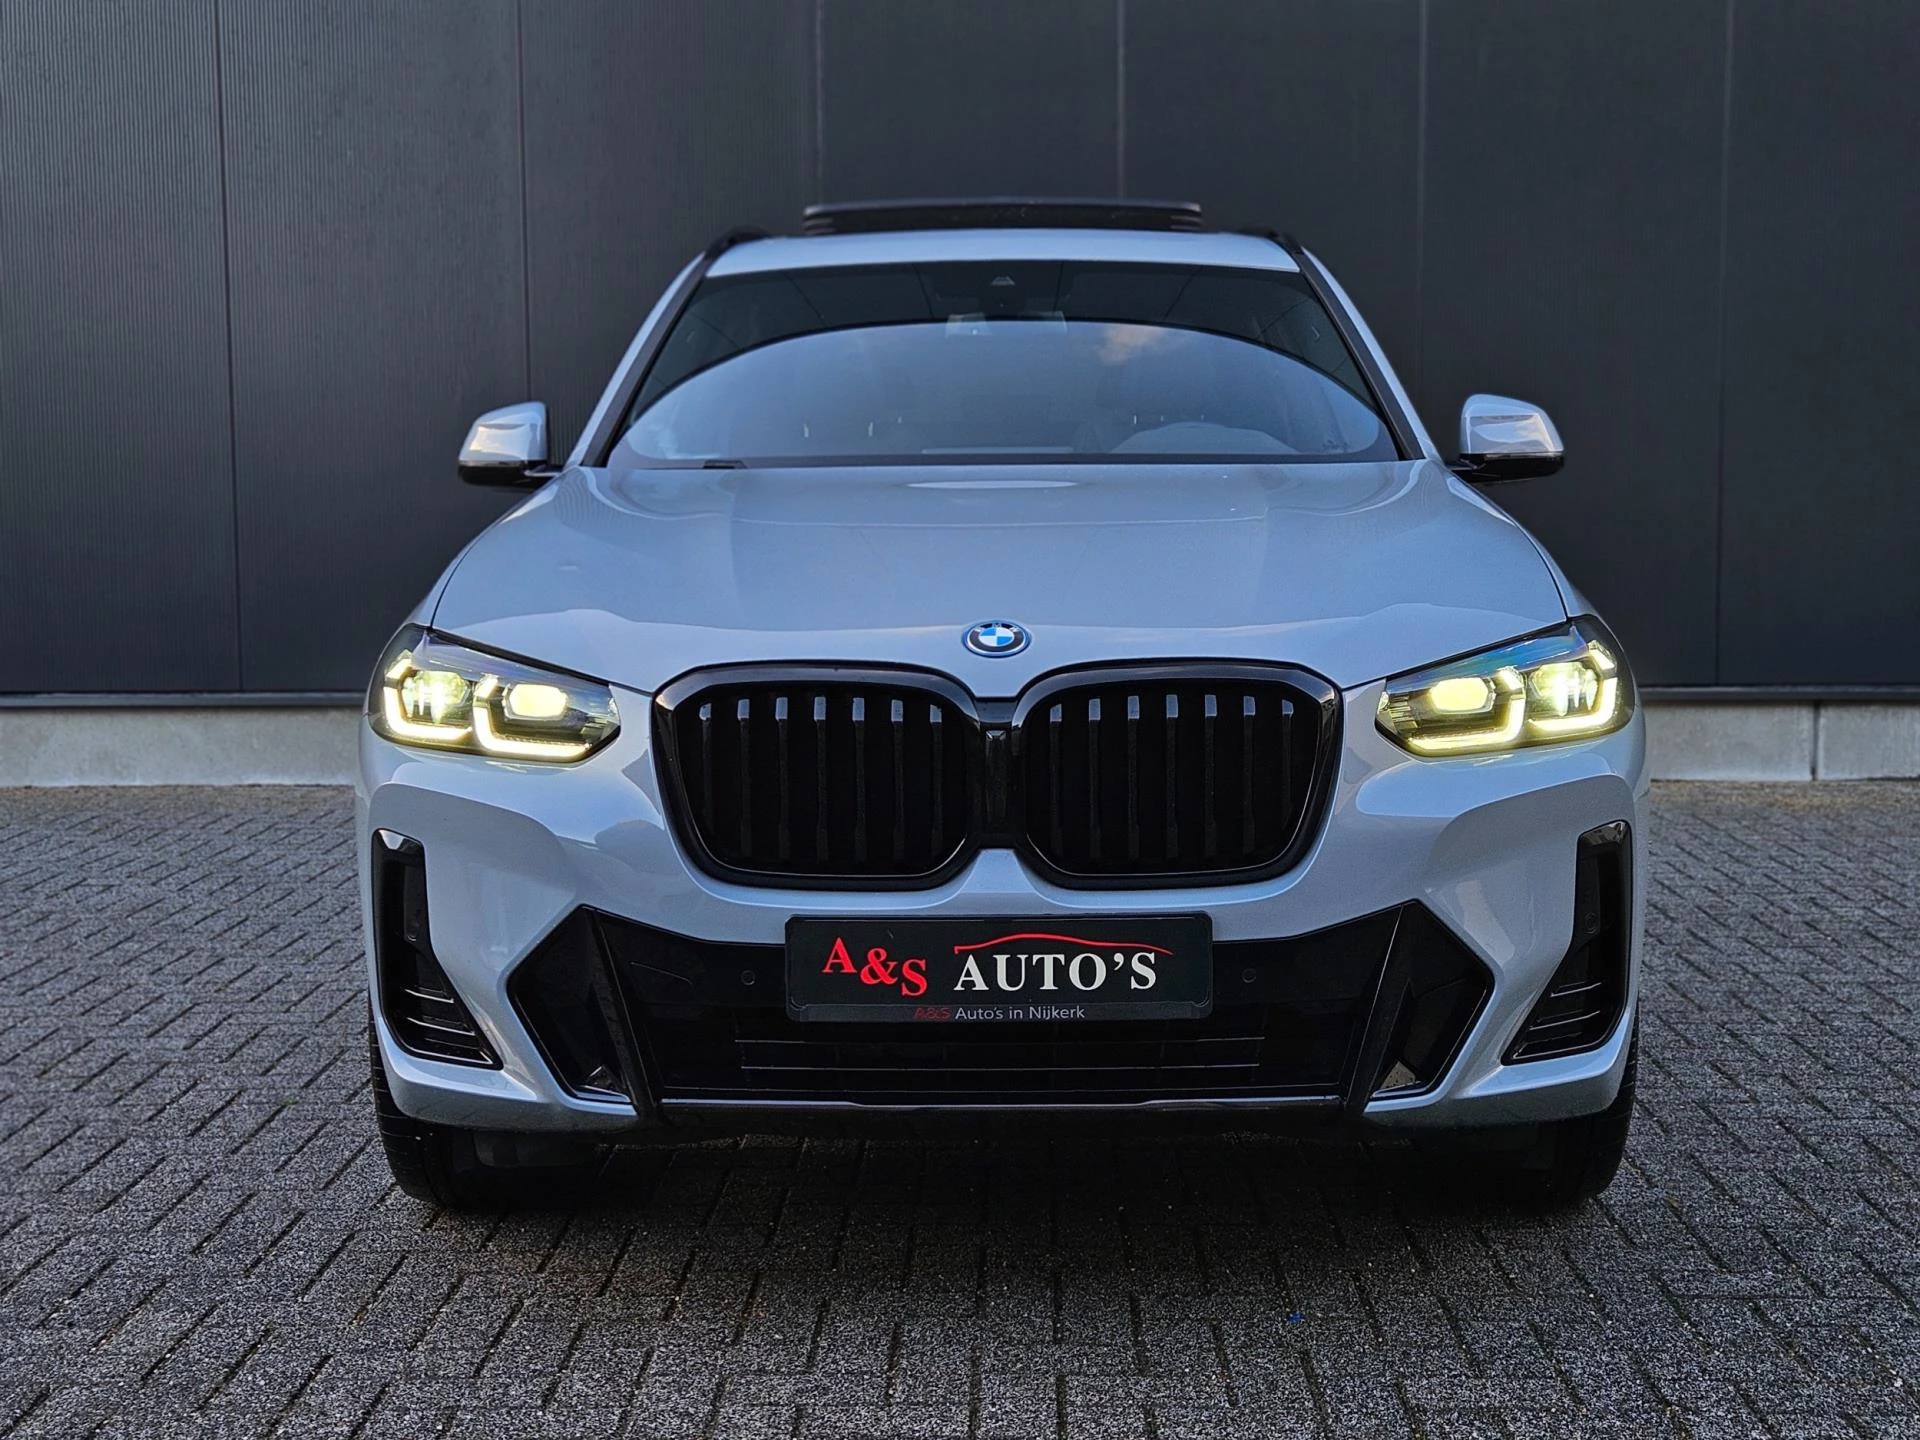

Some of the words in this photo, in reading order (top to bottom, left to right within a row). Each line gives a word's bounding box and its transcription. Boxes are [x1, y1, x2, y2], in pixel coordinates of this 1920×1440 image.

[822, 937, 928, 997] A&S
[954, 952, 1157, 991] AUTO'S
[913, 1008, 951, 1020] A&S
[1009, 1007, 1024, 1020] in
[1029, 1006, 1085, 1021] Nijkerk
